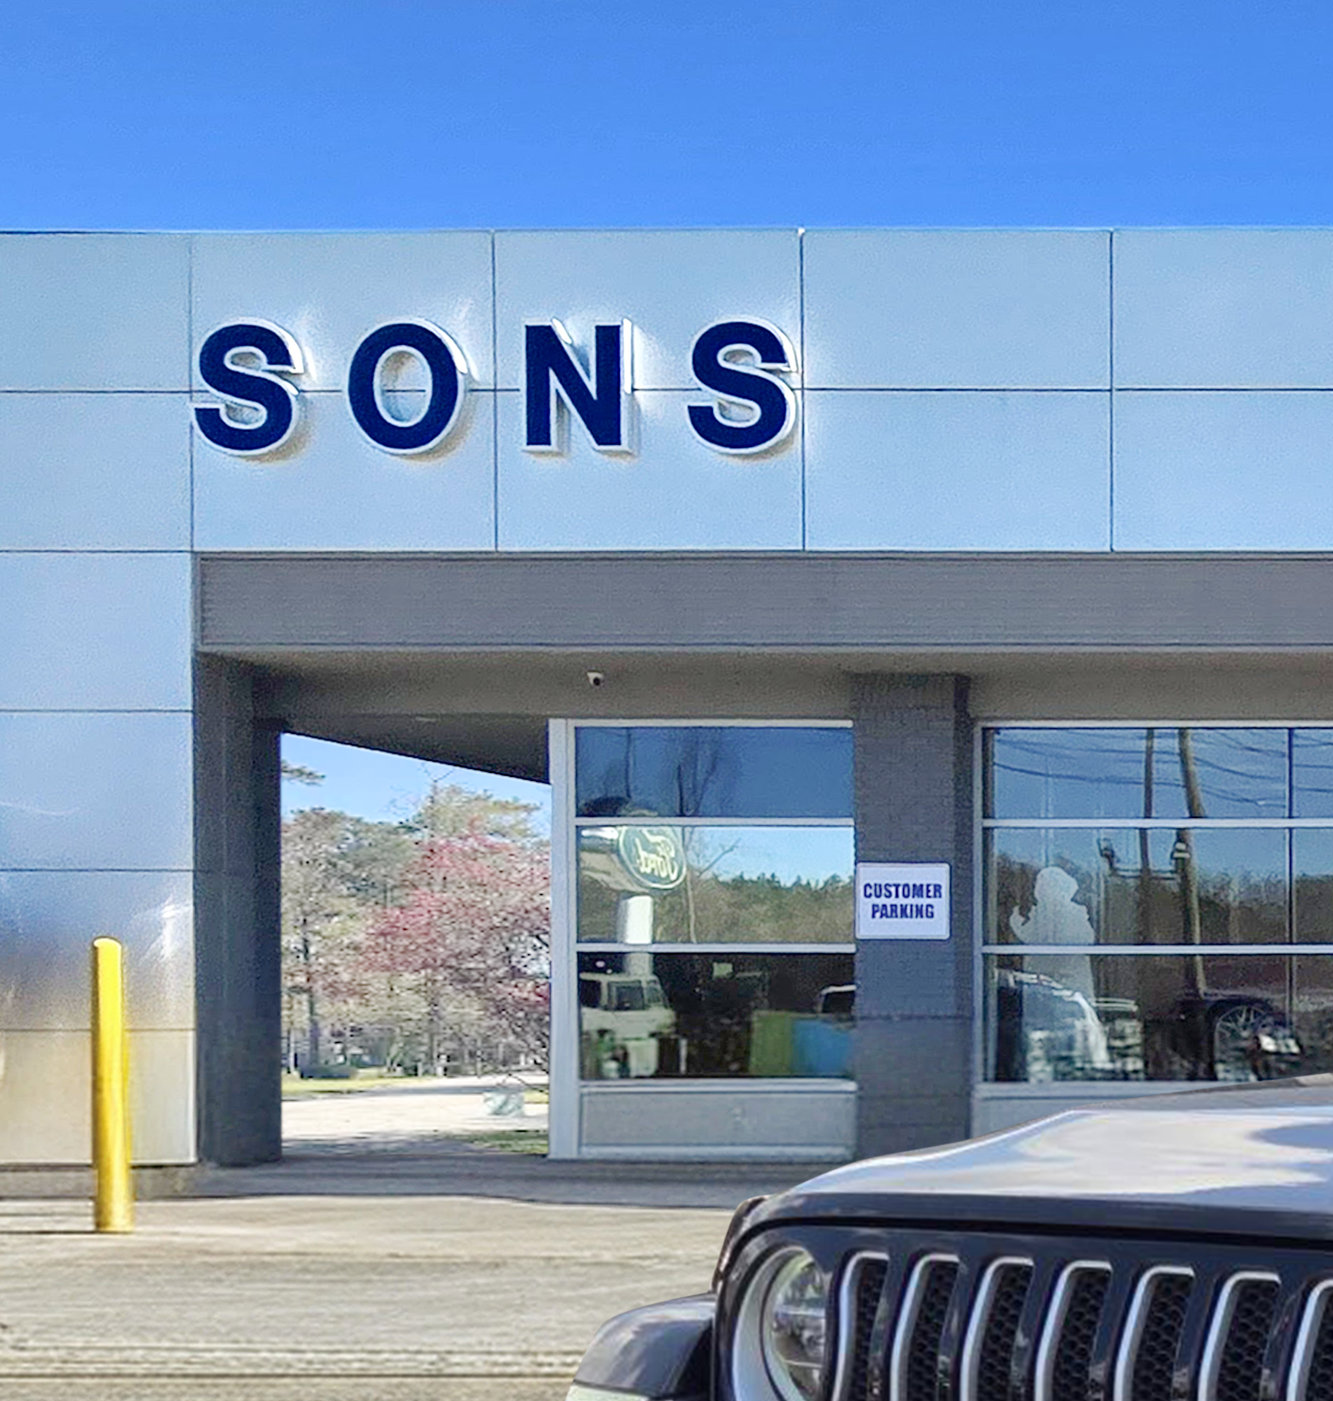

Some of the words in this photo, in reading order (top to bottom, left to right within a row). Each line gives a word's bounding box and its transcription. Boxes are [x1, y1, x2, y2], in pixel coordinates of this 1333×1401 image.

[193, 317, 799, 456] SONS
[862, 882, 943, 900] CUSTOMER
[870, 902, 935, 920] PARKING
